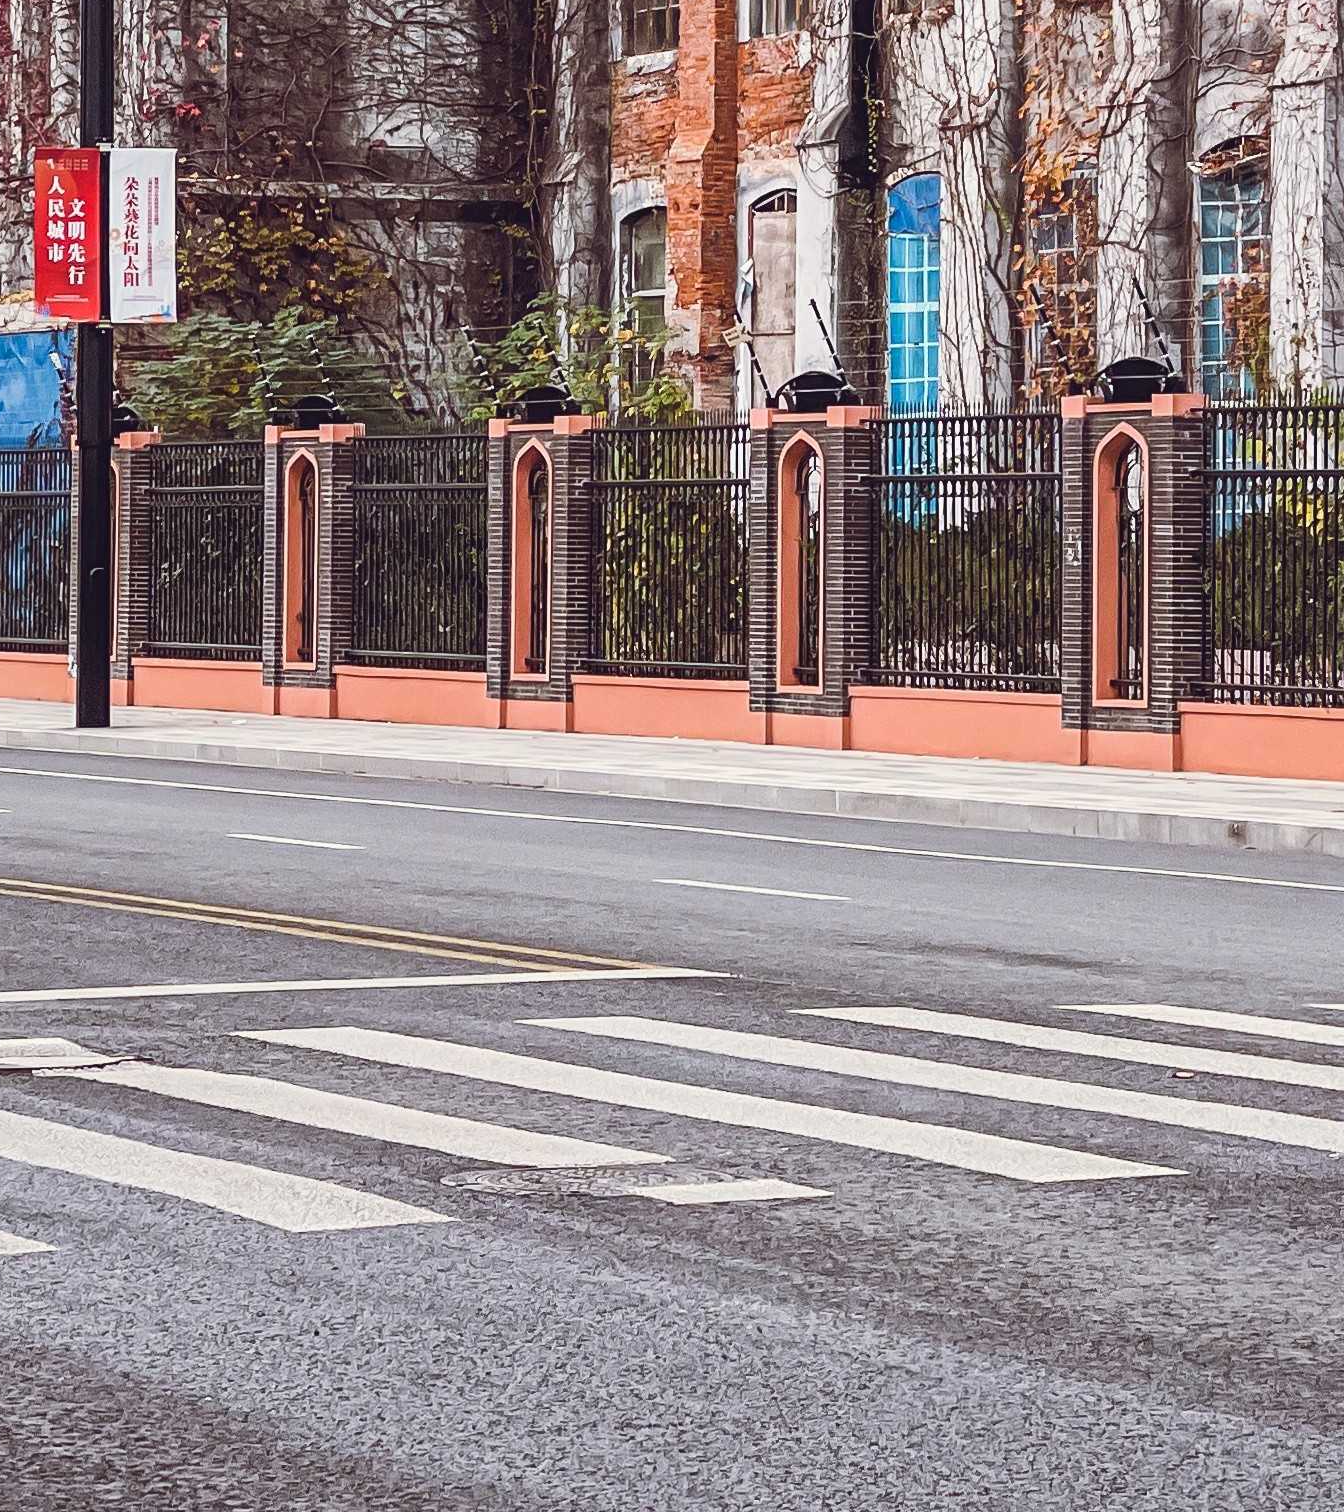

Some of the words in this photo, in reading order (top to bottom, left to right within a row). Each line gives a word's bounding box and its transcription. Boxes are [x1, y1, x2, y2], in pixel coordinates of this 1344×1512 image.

[47, 175, 65, 263] 人民城市
[67, 198, 86, 285] 文明先行
